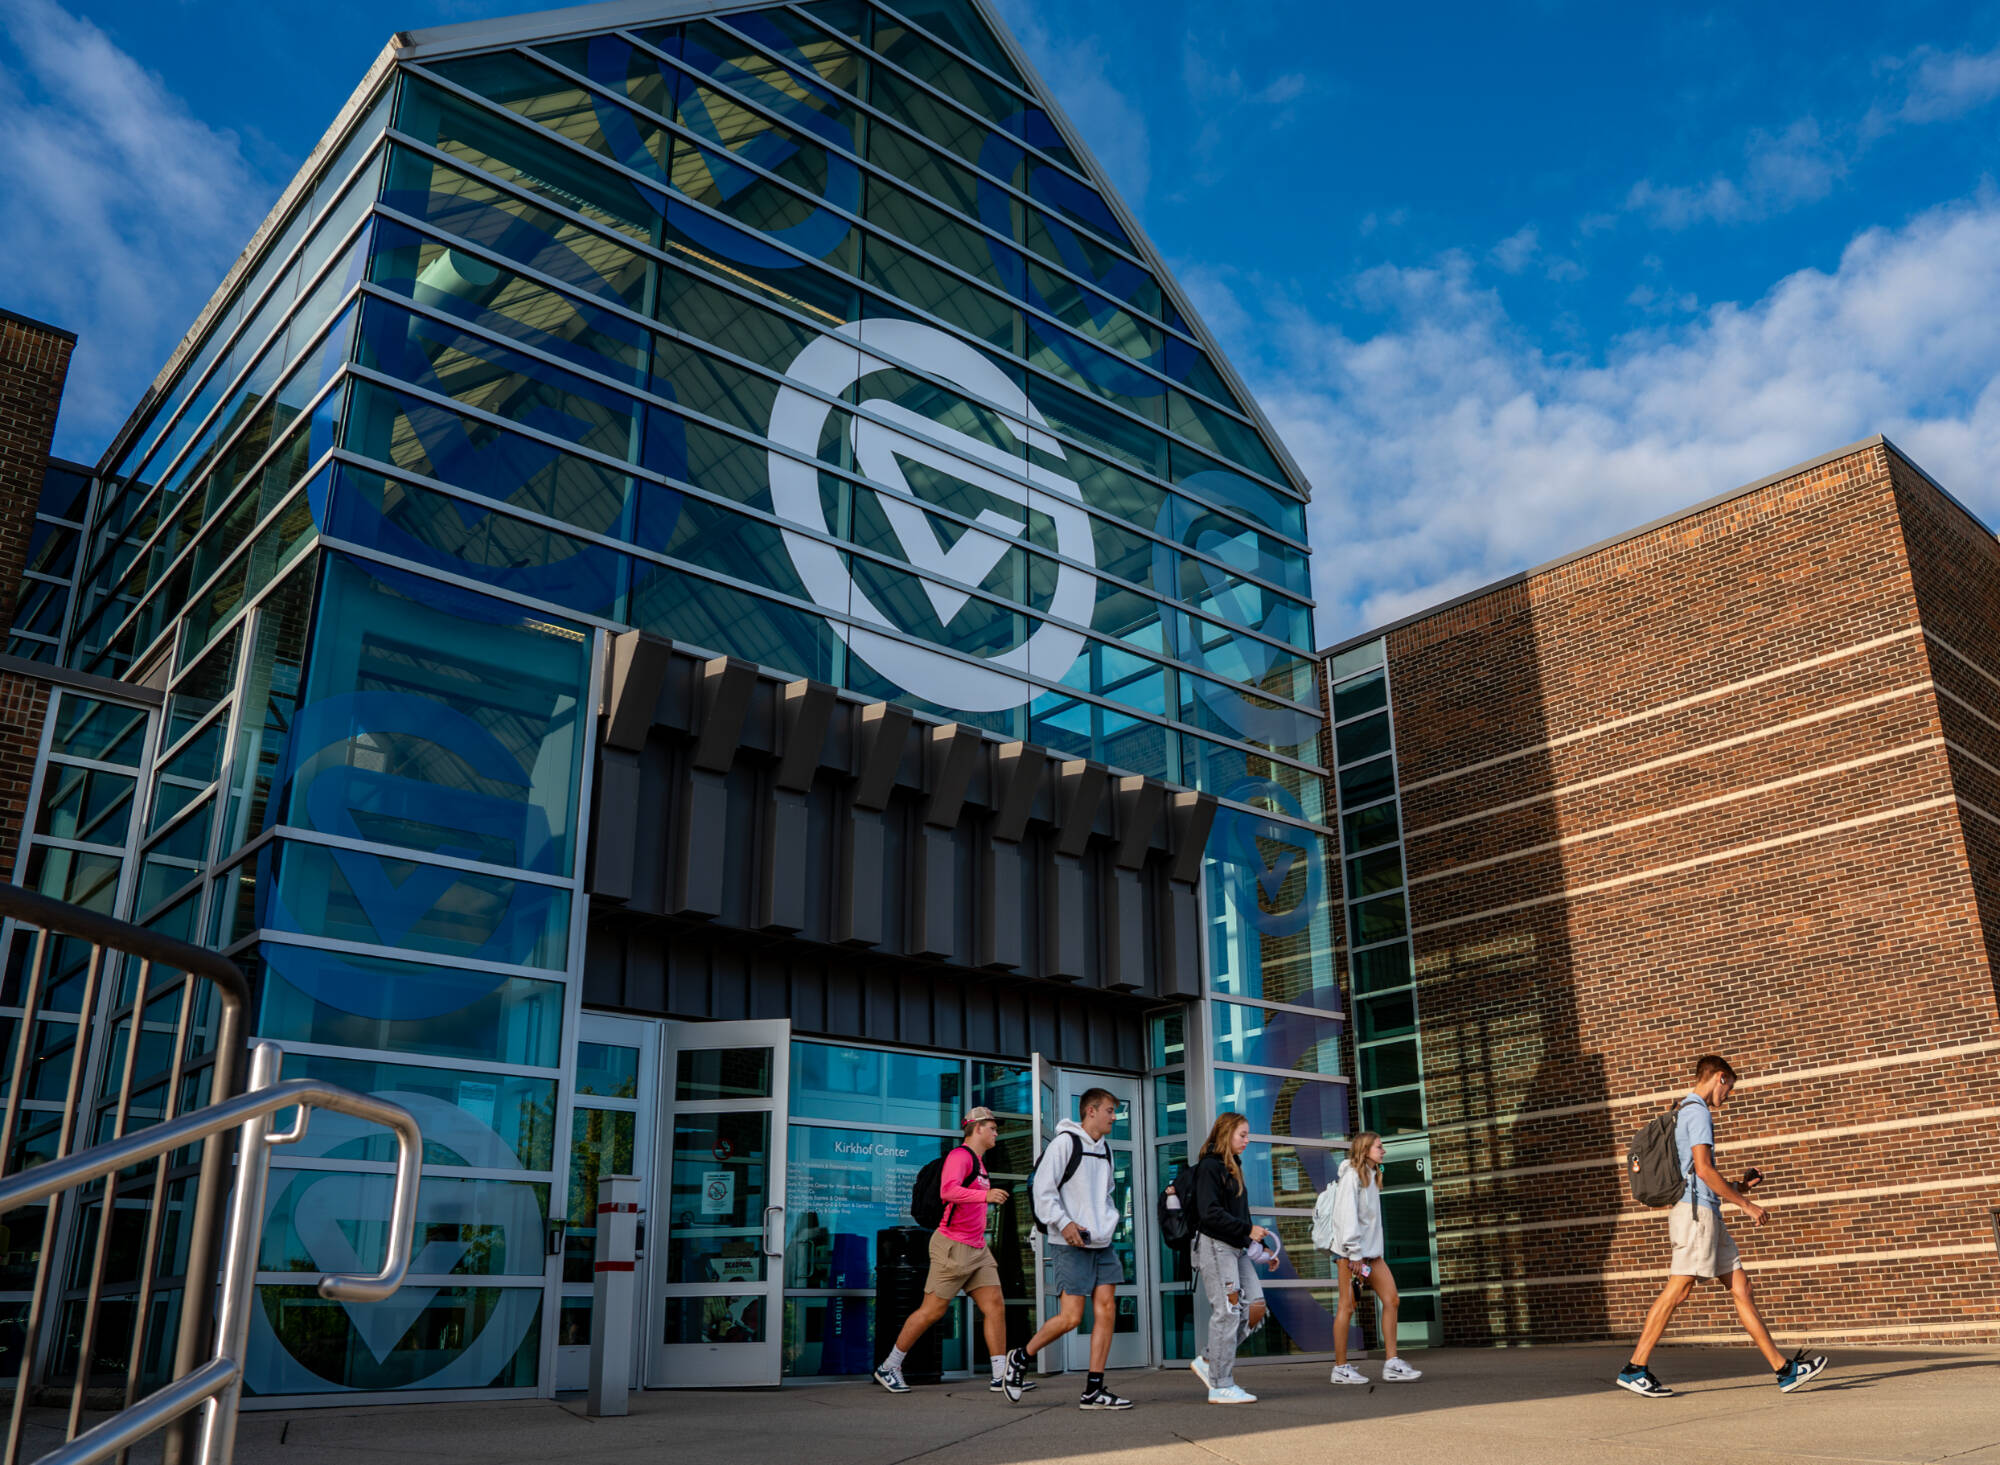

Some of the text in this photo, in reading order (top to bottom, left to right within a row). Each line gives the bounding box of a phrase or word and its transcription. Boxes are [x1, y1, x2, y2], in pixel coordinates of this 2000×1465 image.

[834, 1141, 910, 1157] Kirkhof Center
[1416, 1159, 1424, 1172] 6
